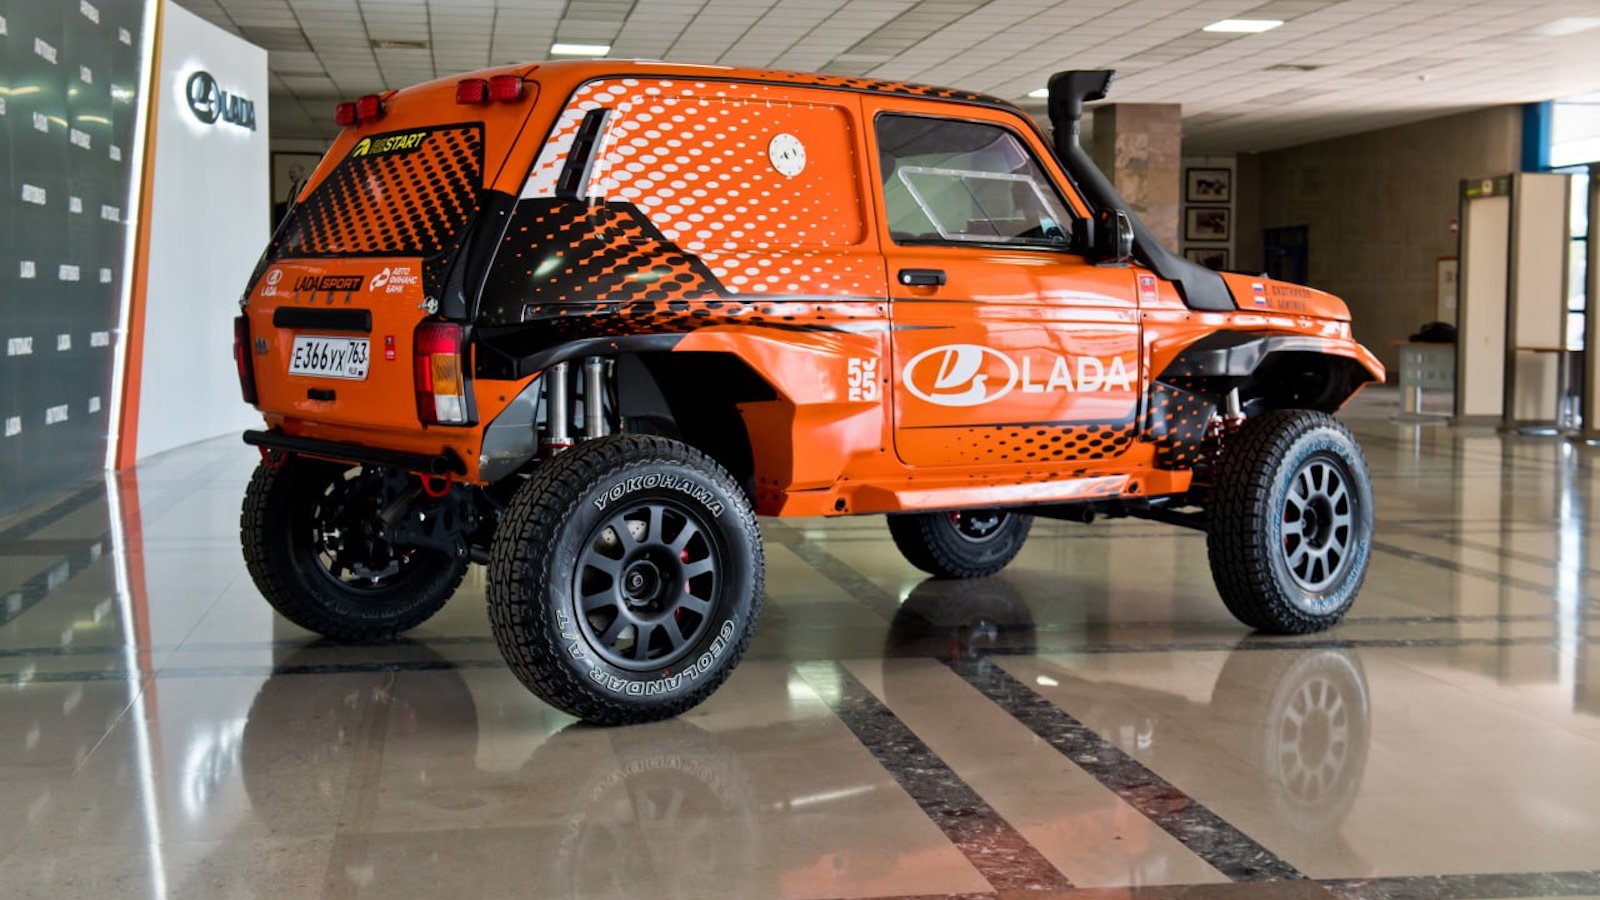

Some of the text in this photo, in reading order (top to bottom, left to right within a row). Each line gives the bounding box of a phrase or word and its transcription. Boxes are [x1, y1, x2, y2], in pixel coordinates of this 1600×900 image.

[220, 90, 257, 131] LADA
[383, 132, 427, 152] START
[294, 275, 362, 291] LADA SPORT
[347, 342, 367, 364] 763
[1022, 356, 1131, 393] LADA
[594, 474, 725, 518] YOKOHAMA
[555, 609, 735, 696] GEOLANDAR A/T
